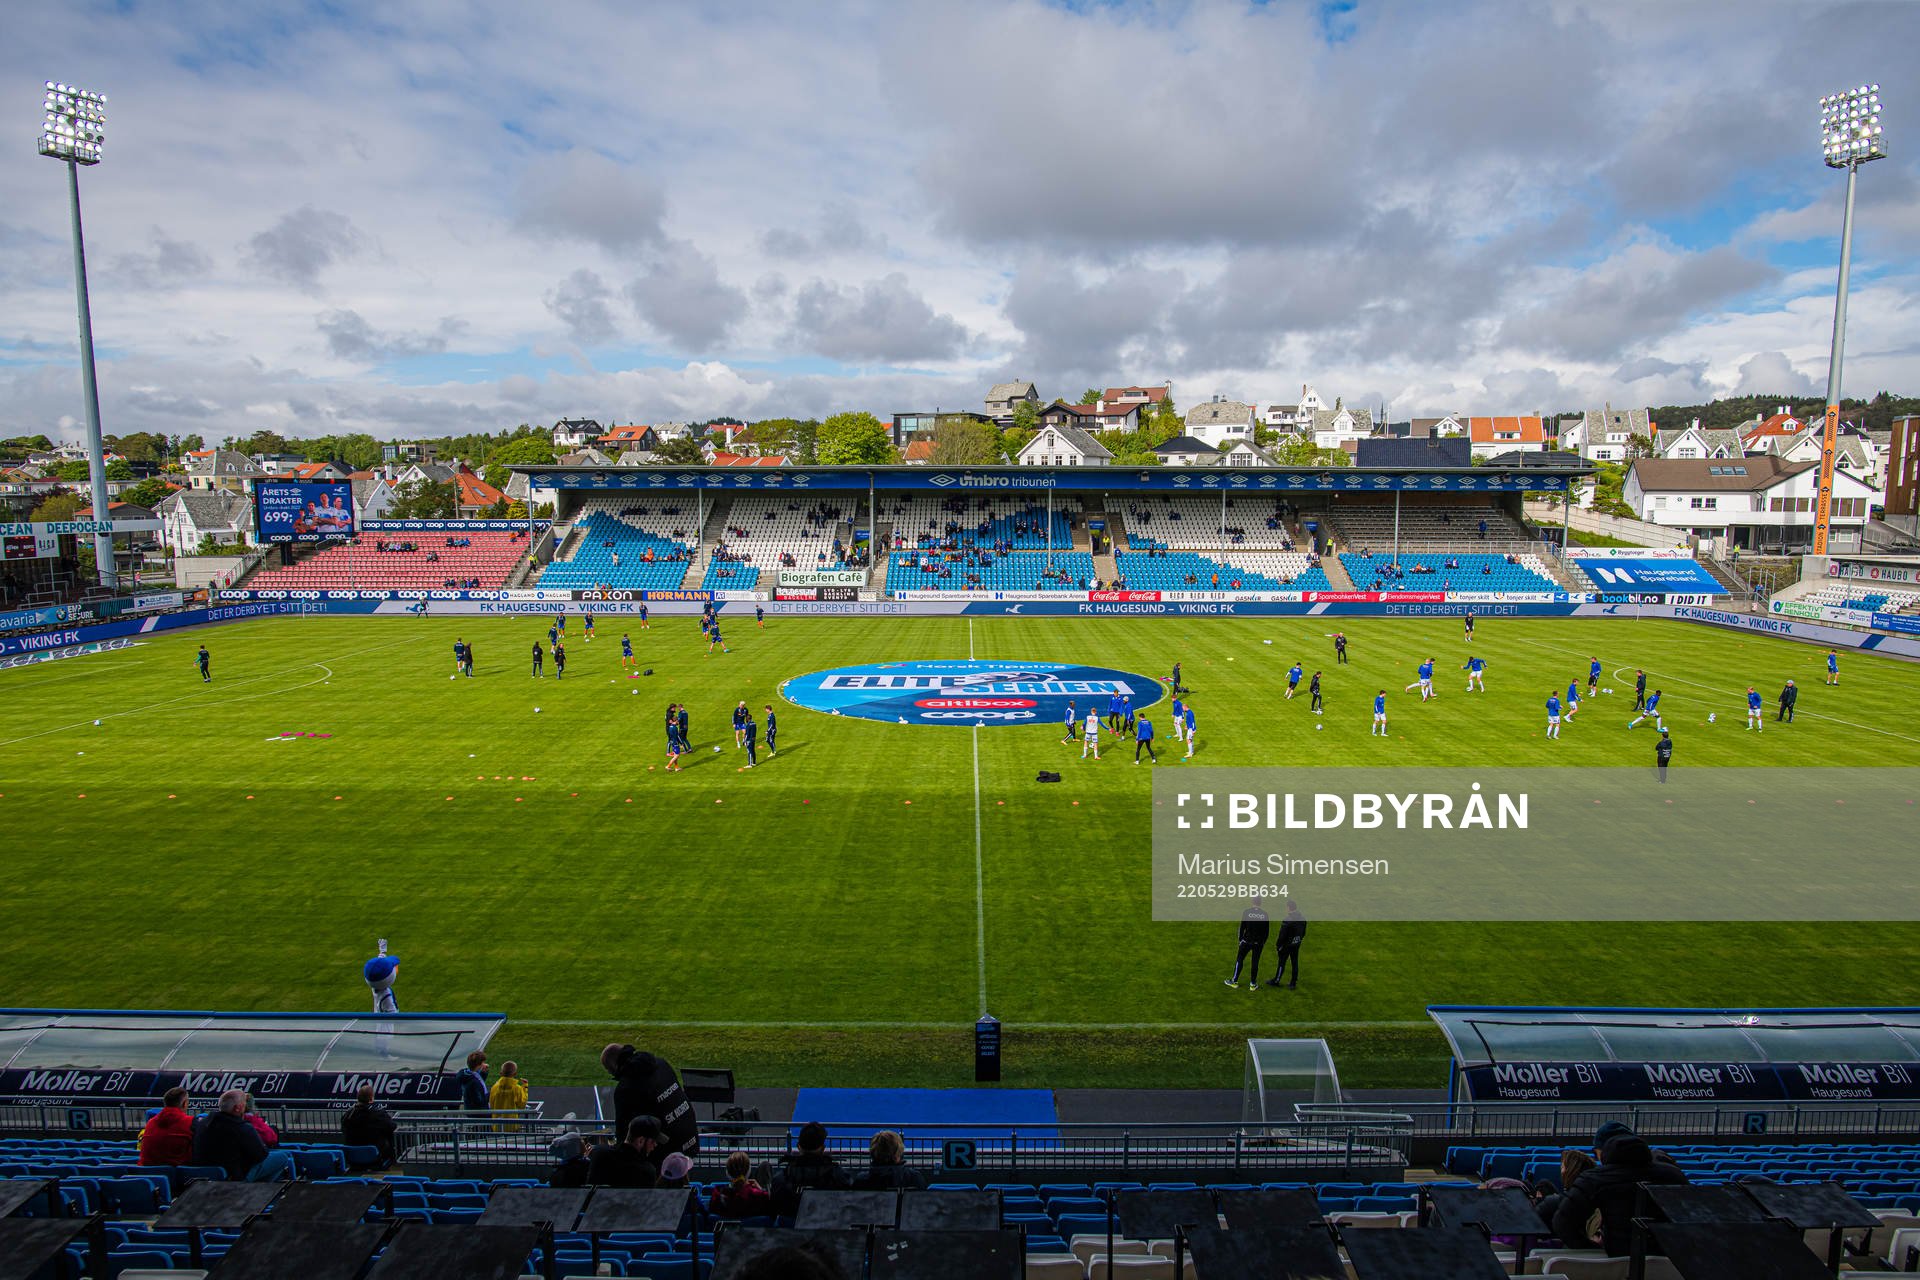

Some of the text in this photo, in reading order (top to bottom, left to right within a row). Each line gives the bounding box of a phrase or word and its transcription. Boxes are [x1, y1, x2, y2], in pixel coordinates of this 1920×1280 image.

[959, 476, 1056, 487] umbro tribunen
[262, 487, 289, 496] ÅRETS
[1820, 494, 1828, 520] TERRASSE
[47, 522, 113, 534] DEEPOCEAN
[782, 573, 834, 584] Biografen
[1882, 570, 1908, 580] HAUBO
[220, 590, 250, 600] coop
[258, 590, 287, 600] coop
[290, 590, 320, 600] coop
[328, 590, 357, 600] coop
[360, 590, 390, 600] coop
[398, 590, 427, 600] coop
[430, 590, 461, 600] coop
[468, 590, 499, 600] coop
[582, 591, 632, 600] PAXON
[1602, 594, 1658, 603] bookbil.no
[1670, 596, 1707, 604] I DID IT
[208, 602, 327, 620] DET ER DERBYET SITT DET!
[498, 604, 565, 612] HAUGESUND
[579, 604, 616, 612] VIKING
[773, 604, 906, 612] DET ER DERBYET SITT DET!
[1079, 604, 1234, 613] FK HAUGESUND VIKING FK
[1386, 605, 1517, 614] DET ER DERBYET SITT DET!
[1784, 602, 1824, 612] EFFEKTIVT
[68, 610, 94, 621] SECURE
[1784, 609, 1820, 618] RENHOLD
[0, 612, 36, 629] avaria
[1674, 608, 1792, 633] FK HAUGESUND VIKING FK
[20, 632, 62, 650] VIKING
[65, 630, 80, 643] FK
[832, 676, 966, 687] ELITE
[962, 681, 1120, 693] SERIEN
[920, 711, 1036, 720] coop
[1575, 1064, 1602, 1083] Bil
[1726, 1064, 1756, 1084] Bil
[1881, 1064, 1912, 1084] Bil
[104, 1071, 134, 1092] Bil
[261, 1073, 290, 1093] Bil
[416, 1074, 444, 1094] Bil
[1498, 1087, 1560, 1099] Haugesund
[1653, 1087, 1714, 1099] Haugesund
[1810, 1087, 1872, 1099] Haugesund
[72, 1111, 88, 1128] R
[1748, 1115, 1763, 1132] R
[950, 1143, 971, 1166] R
